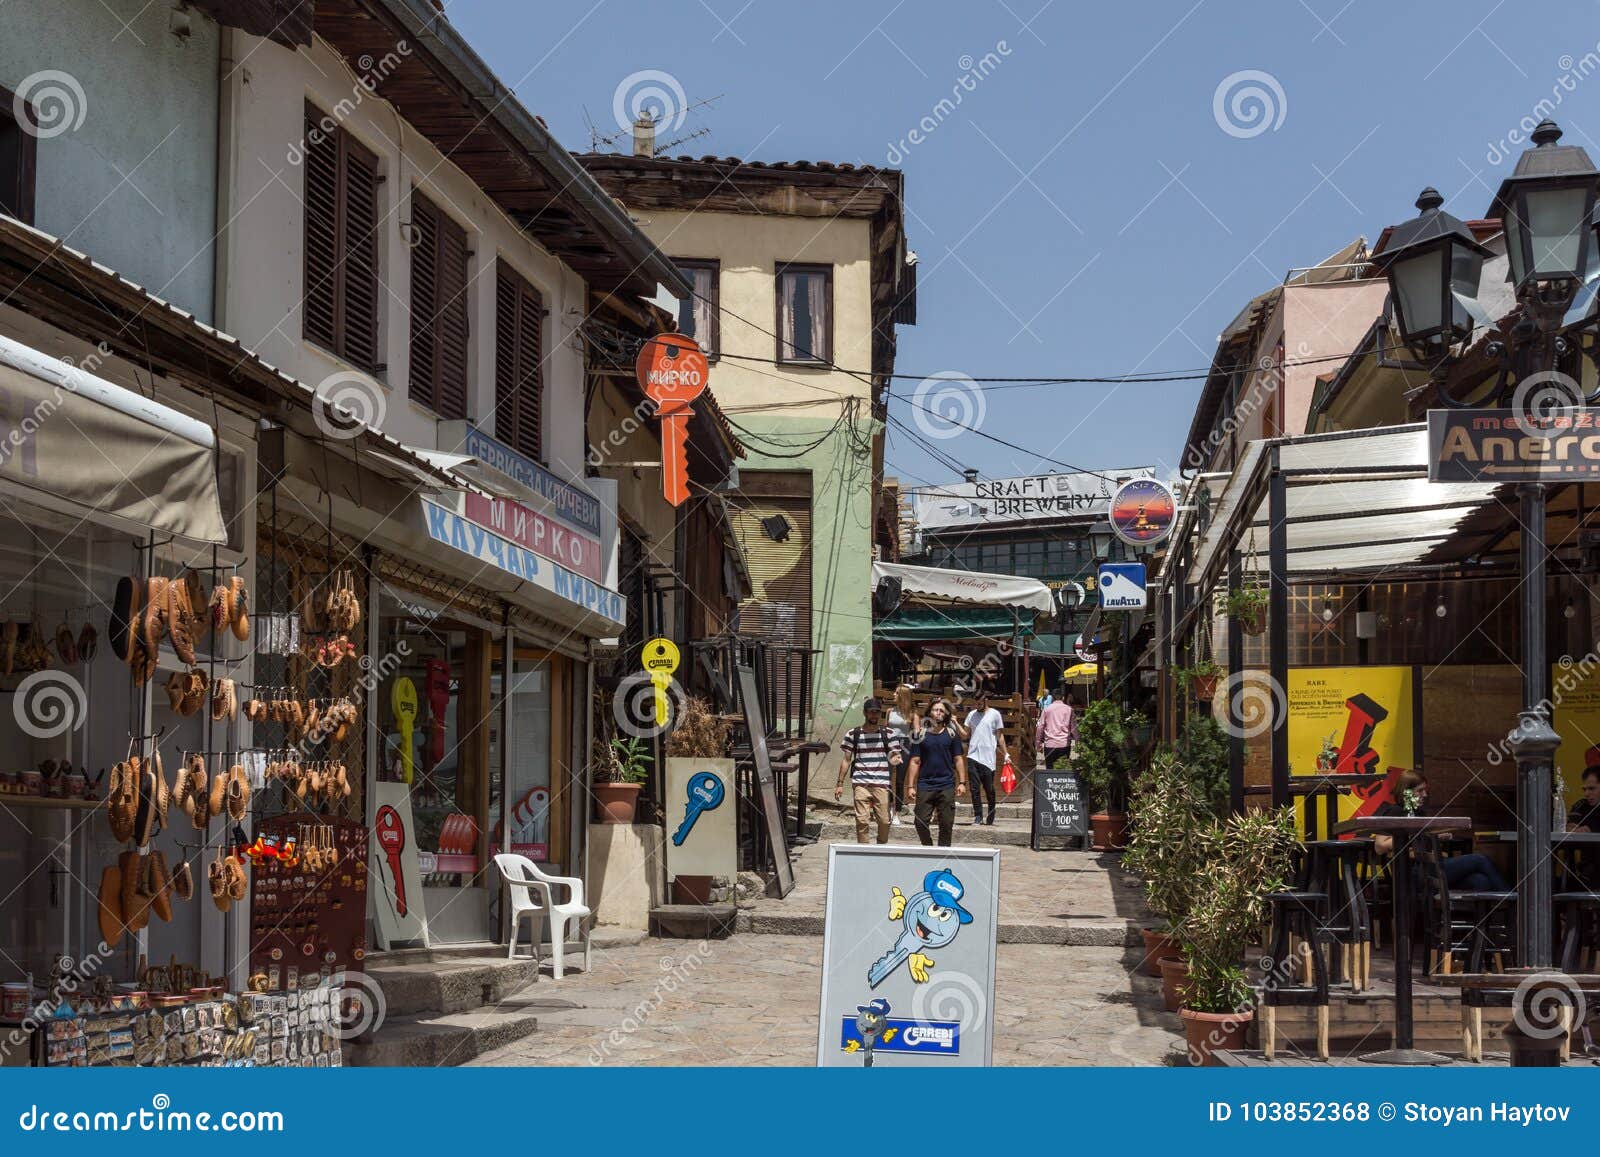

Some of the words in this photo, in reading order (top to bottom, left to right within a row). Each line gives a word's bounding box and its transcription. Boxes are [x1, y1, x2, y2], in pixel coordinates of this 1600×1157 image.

[646, 370, 700, 386] МИРКО
[468, 436, 524, 483] СЕРВИС
[525, 468, 543, 496] ЗА
[545, 481, 599, 529] КЛУЧЕВИ
[975, 477, 1049, 498] CRAFT
[994, 493, 1096, 516] BREWERY
[490, 500, 583, 566] МИРКО
[427, 503, 540, 581] КЛУЧАР
[551, 564, 621, 621] МИРКО
[951, 575, 991, 593] Melody
[1106, 596, 1141, 606] LAVAZZA
[1044, 788, 1080, 801] DRAUGHT
[1052, 801, 1078, 812] BEER
[1056, 815, 1071, 825] 100
